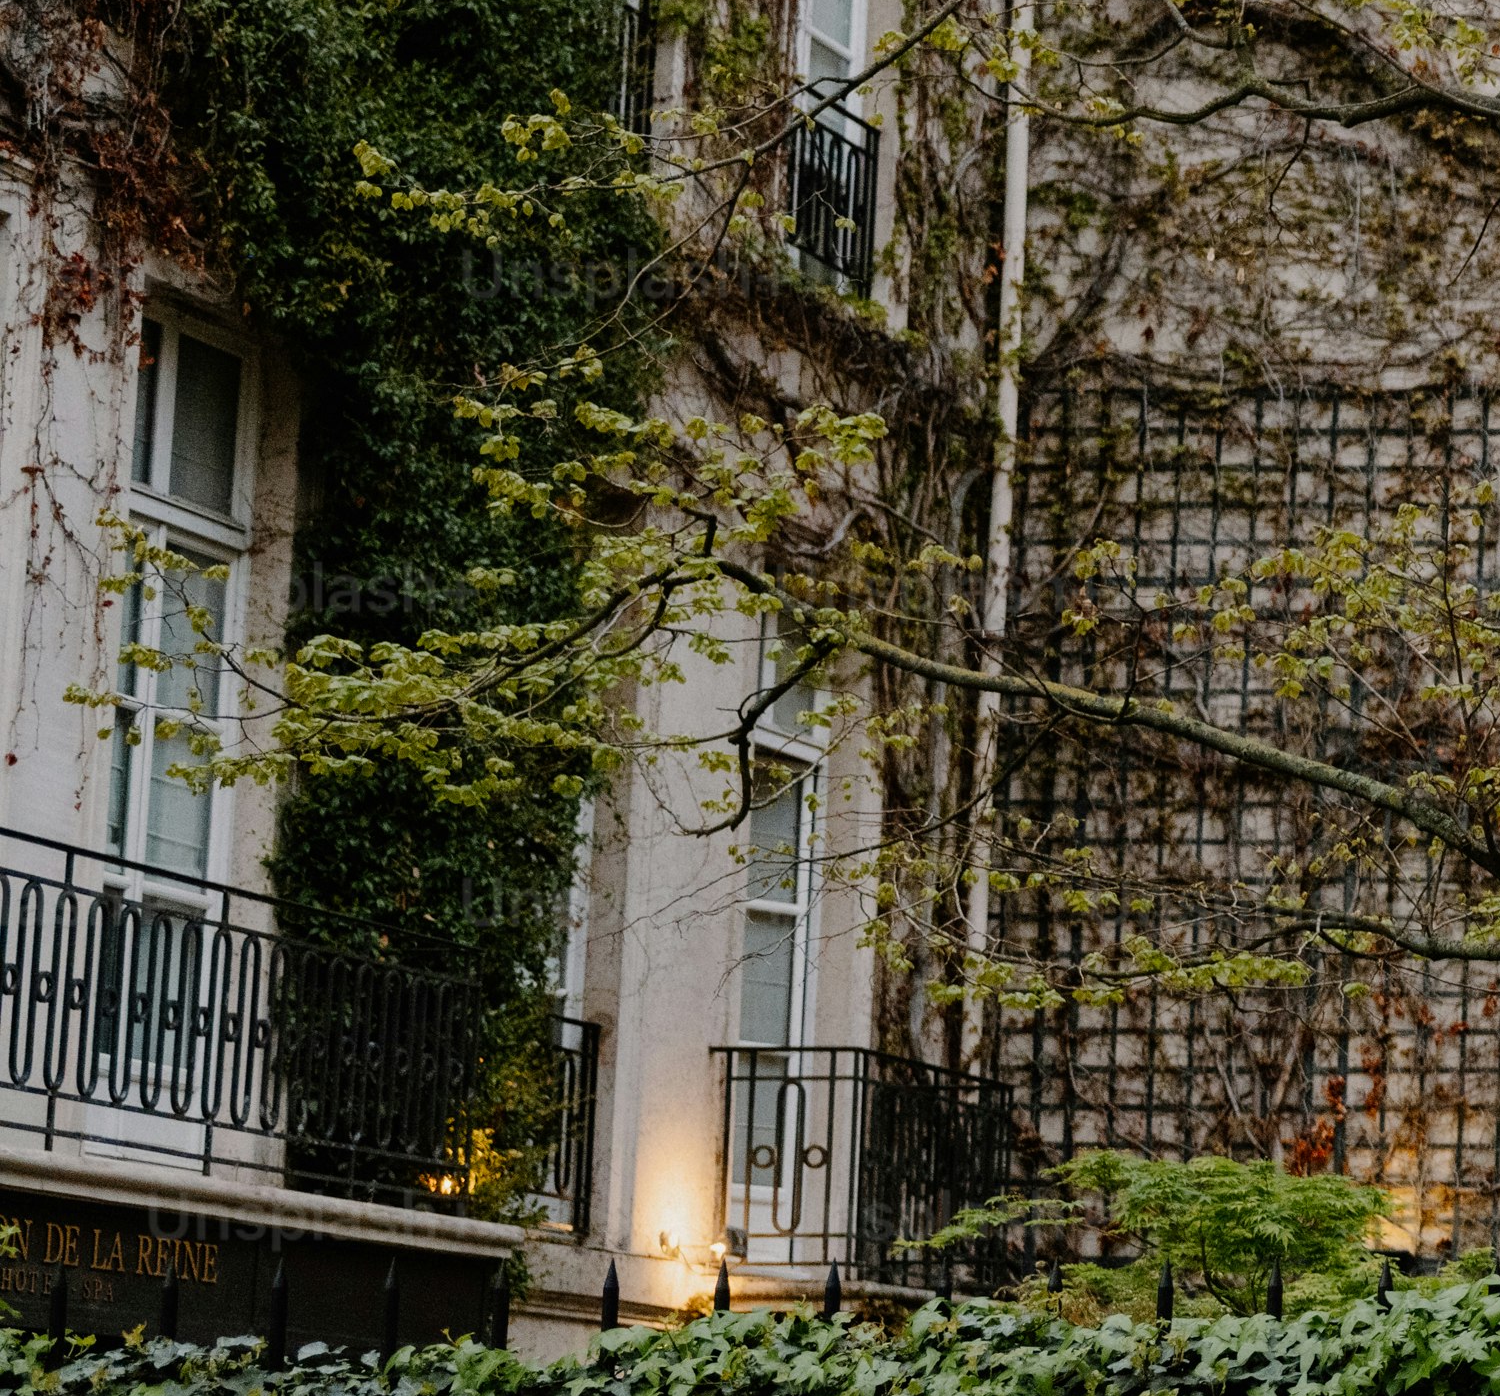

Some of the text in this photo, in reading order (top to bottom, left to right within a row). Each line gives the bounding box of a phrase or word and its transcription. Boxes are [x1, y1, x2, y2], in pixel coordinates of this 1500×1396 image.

[43, 1222, 81, 1267] DE
[90, 1228, 125, 1273] LA
[135, 1234, 219, 1284] REINE
[82, 1277, 114, 1303] SPA
